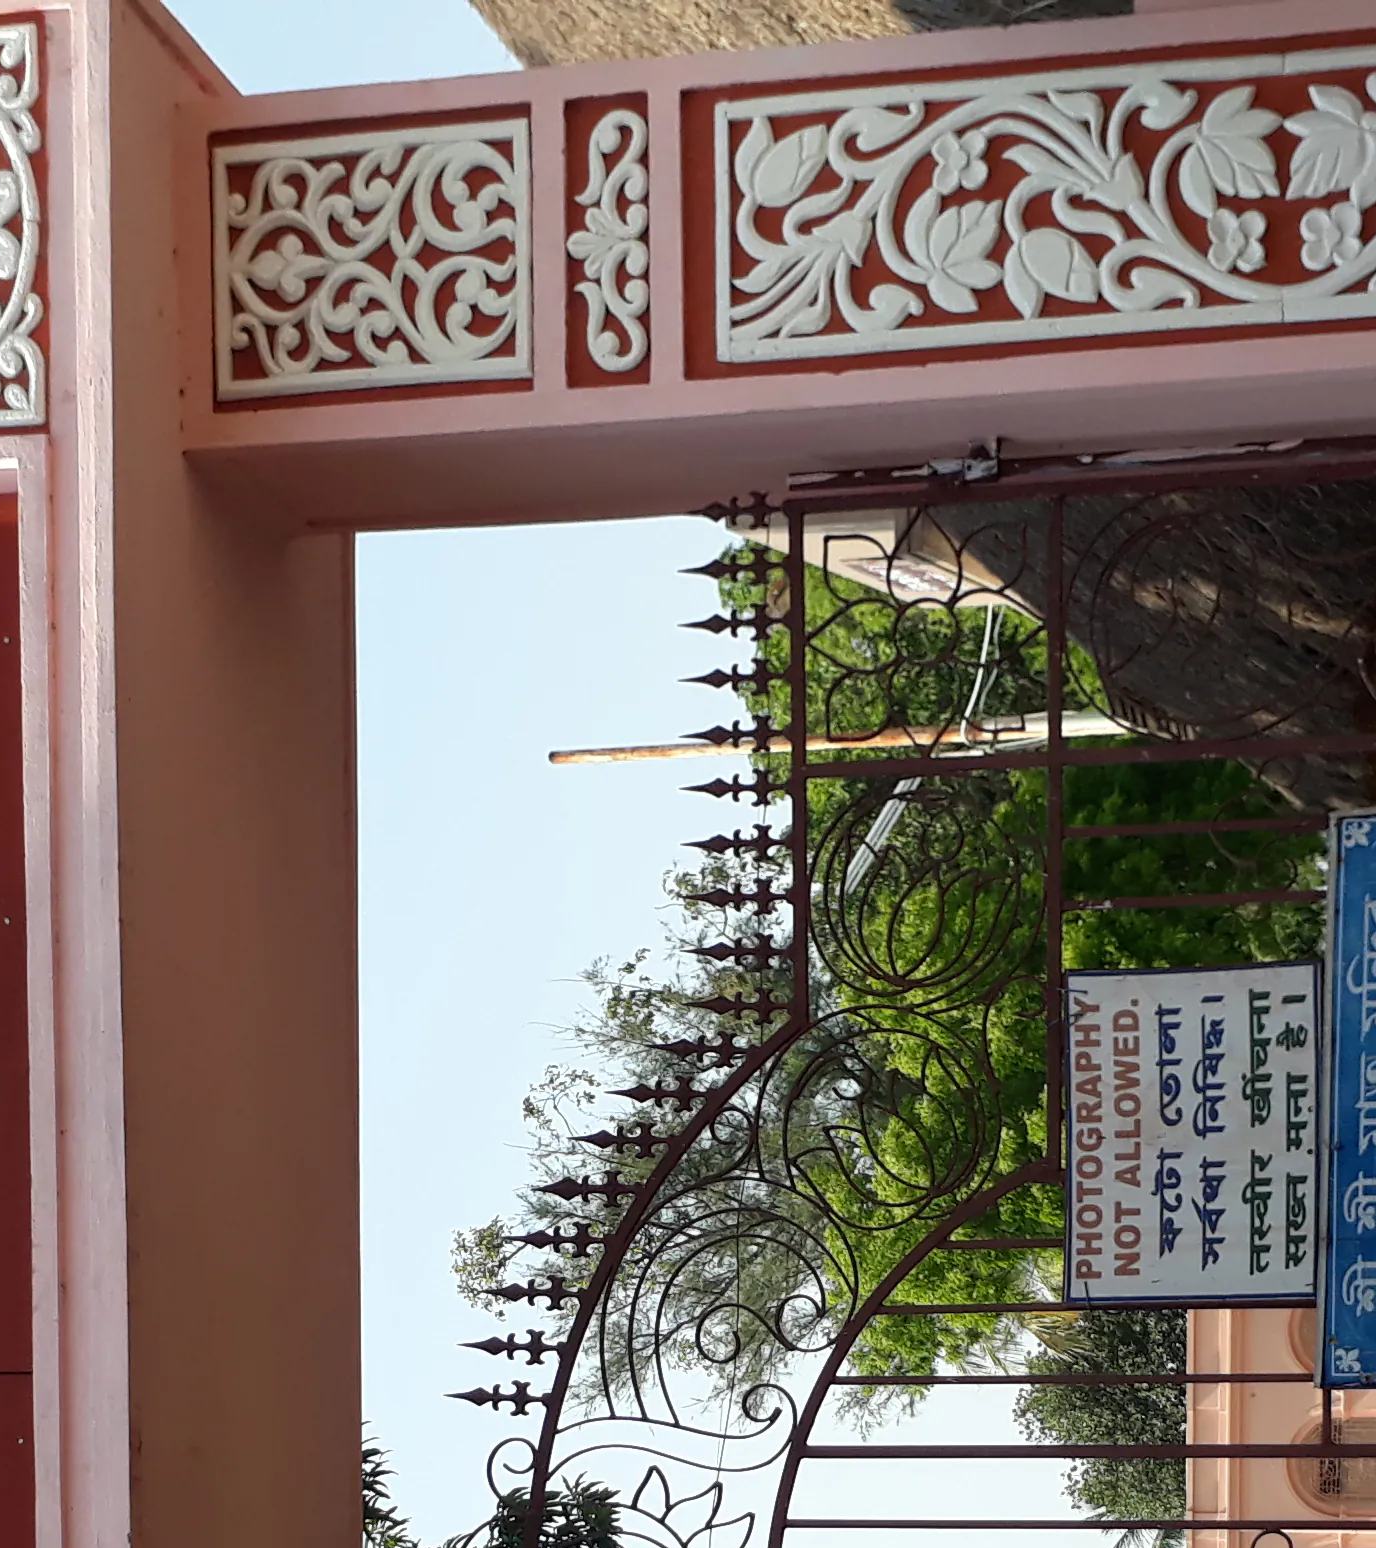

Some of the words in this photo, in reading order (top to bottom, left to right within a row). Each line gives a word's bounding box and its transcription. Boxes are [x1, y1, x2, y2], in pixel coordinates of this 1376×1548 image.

[1113, 998, 1141, 1188] ALLOWED.
[1154, 1004, 1182, 1126] তোলা
[1241, 988, 1271, 1127] खींचना
[1285, 1072, 1308, 1152] मना
[1074, 996, 1103, 1280] PHOTOGRAPHY
[1114, 1201, 1141, 1277] NOT
[1151, 1148, 1183, 1259] ফটো
[1191, 1156, 1225, 1271] সর্বথা
[1242, 1149, 1272, 1275] तस्वीर
[1284, 1173, 1307, 1269] सख्त
